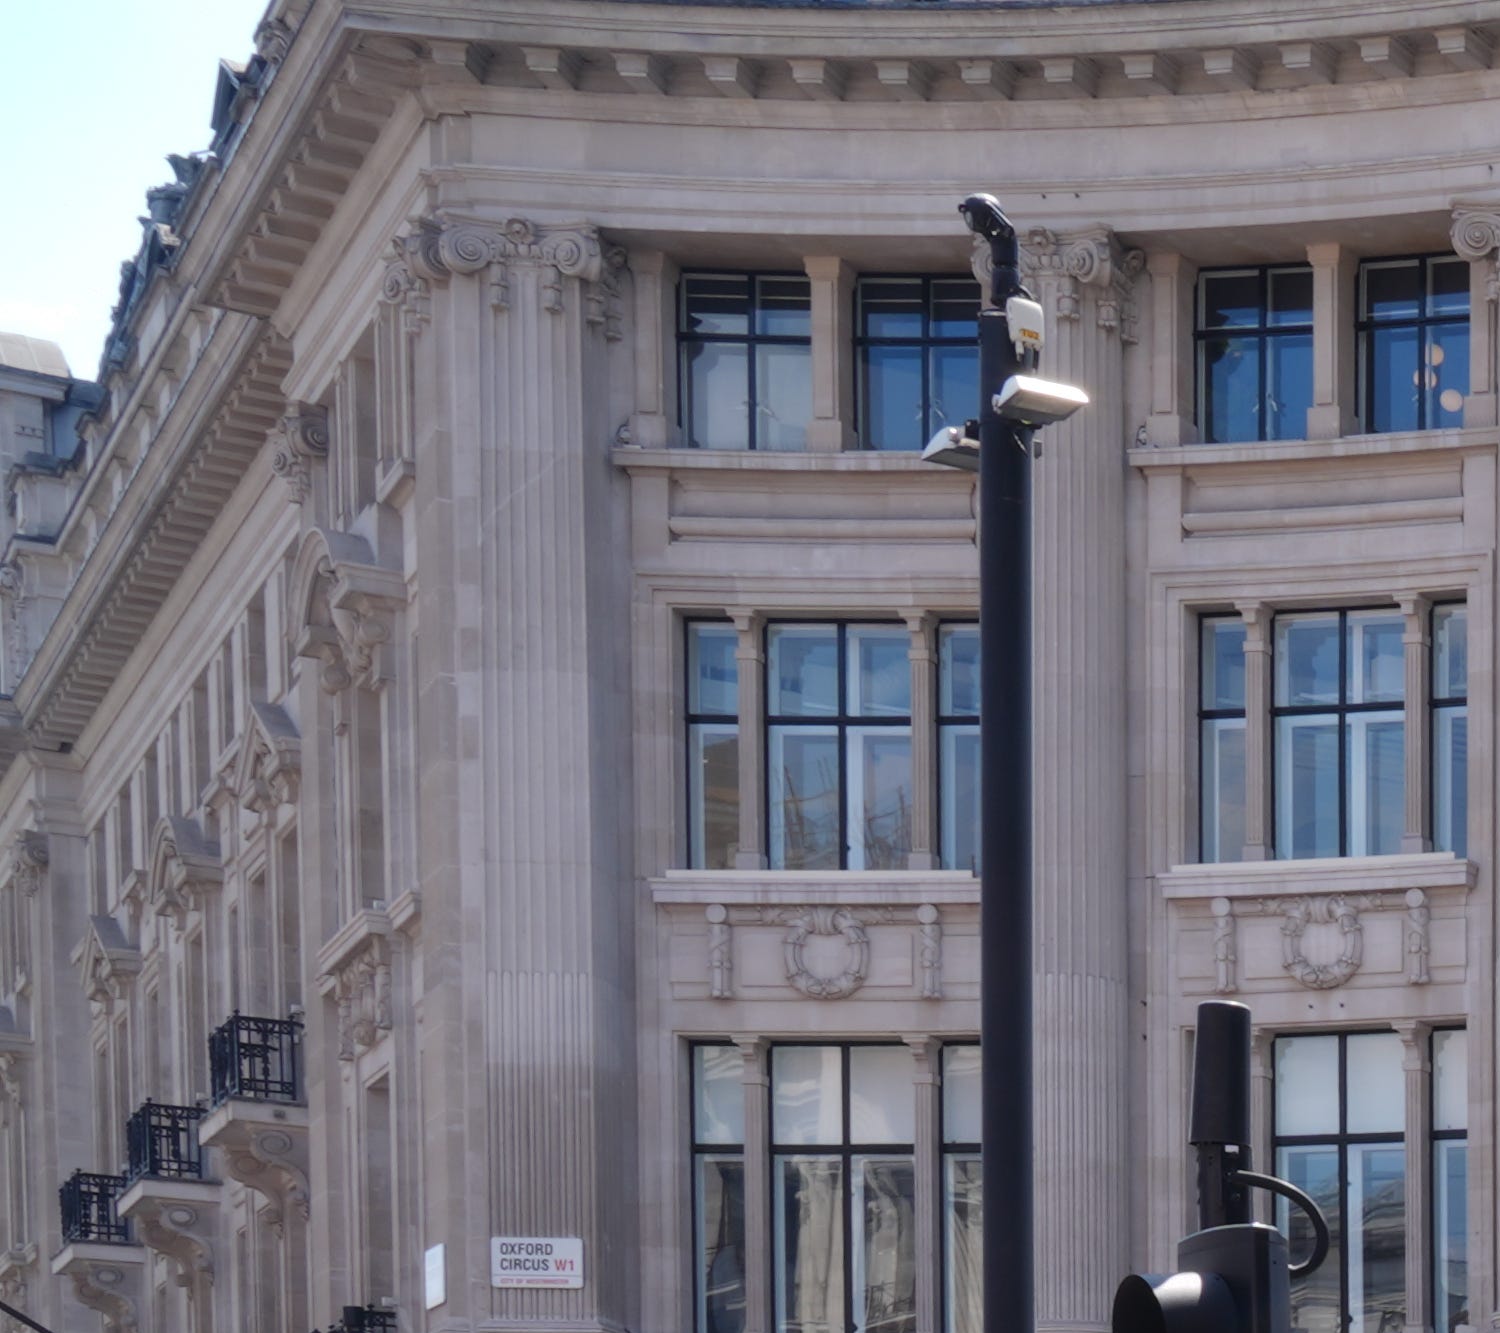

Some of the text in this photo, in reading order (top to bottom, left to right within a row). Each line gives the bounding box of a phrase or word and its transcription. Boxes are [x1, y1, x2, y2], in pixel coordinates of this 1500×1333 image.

[500, 1242, 553, 1255] OXFORD
[500, 1258, 574, 1271] CIRCUS W1
